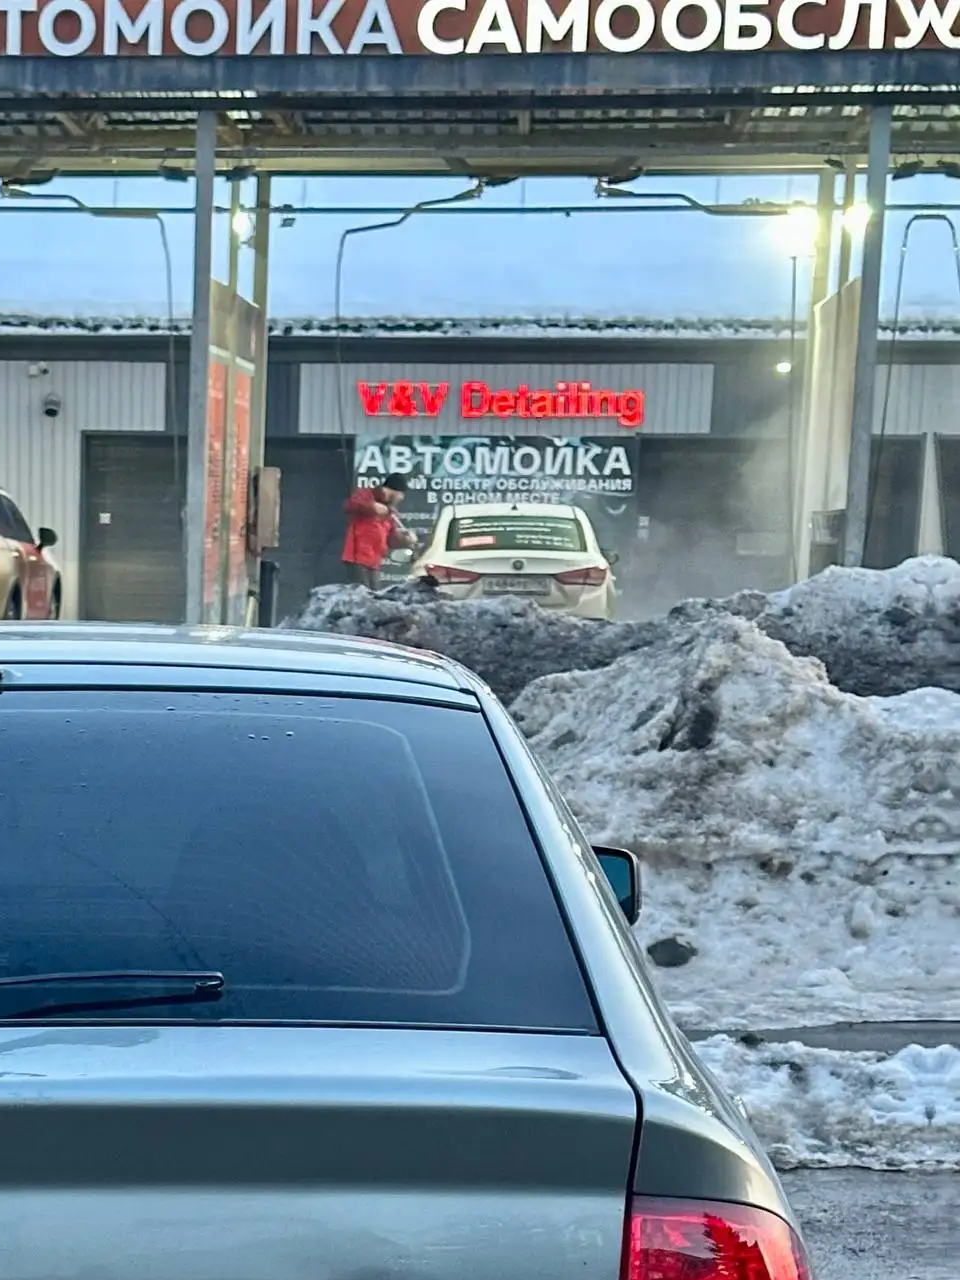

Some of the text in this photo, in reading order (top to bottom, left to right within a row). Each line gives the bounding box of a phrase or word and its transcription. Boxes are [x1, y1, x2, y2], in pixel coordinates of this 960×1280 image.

[356, 380, 645, 426] V&V Detailing
[357, 436, 633, 476] АВТОМОЙКА
[430, 477, 491, 491] СПЕКТР
[496, 477, 633, 491] ОБСЛУЖИВАНИЯ
[427, 491, 561, 505] В ОДНОМ МЕСТЕ
